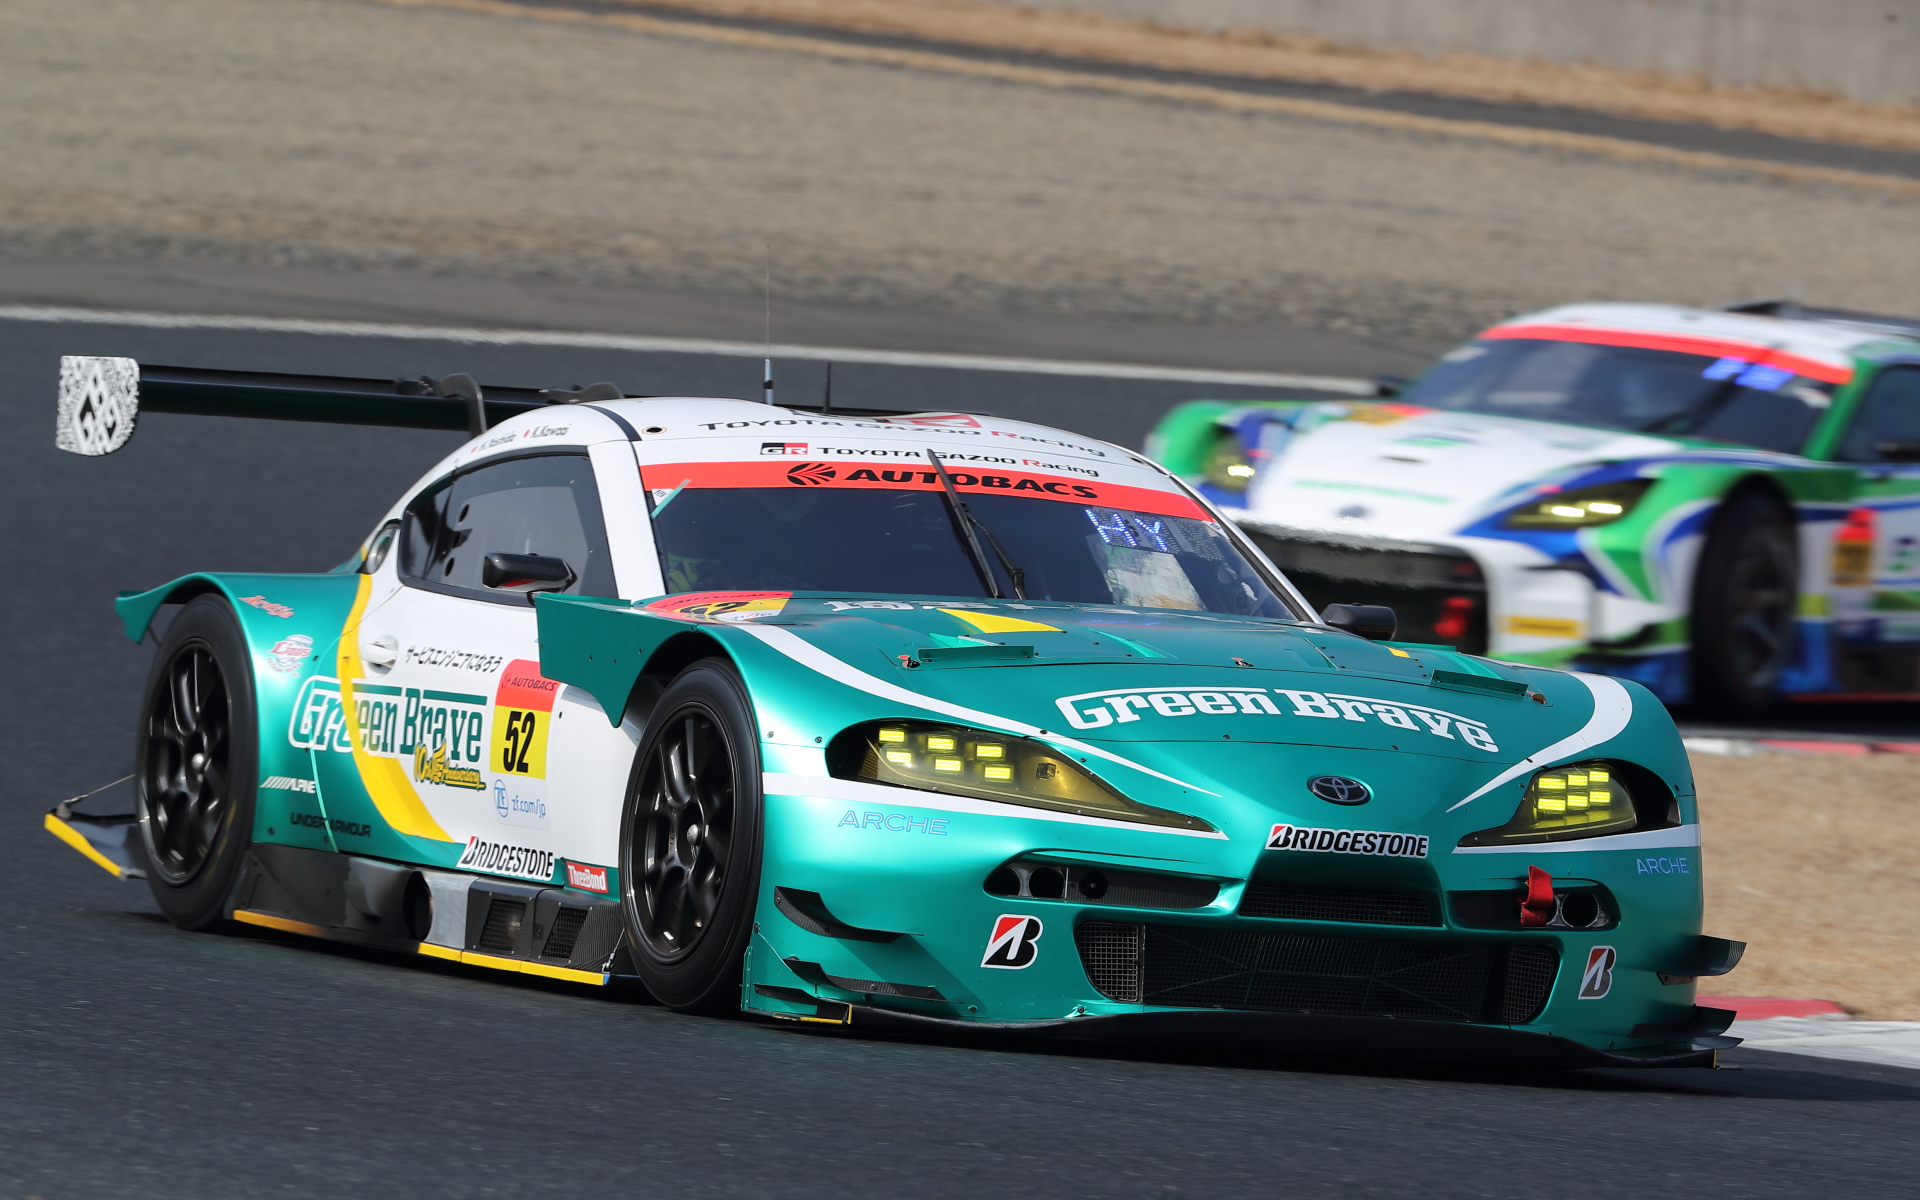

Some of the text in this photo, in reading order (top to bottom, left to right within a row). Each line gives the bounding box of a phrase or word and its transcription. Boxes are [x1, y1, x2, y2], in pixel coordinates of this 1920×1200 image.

[697, 419, 1106, 457] TOYOTA GAZOO Racing
[816, 447, 1100, 477] TOYOTA GAZOO Racing
[844, 469, 1099, 498] AUTOBACS
[405, 645, 503, 673] サービスエンジニアになろう
[511, 677, 557, 691] AUTOBACS
[400, 688, 488, 763] Brave
[1055, 686, 1499, 753] Green Brave
[503, 711, 535, 773] 52
[511, 795, 547, 819] zf.com/jp
[290, 812, 371, 837] UNDER ARMOUR
[837, 810, 950, 836] ARCHE
[1267, 824, 1429, 859] BRIDGESTONE
[460, 836, 554, 878] BRIDGESTONE
[1636, 857, 1690, 875] ARCHE
[567, 864, 608, 891] ThreeBond
